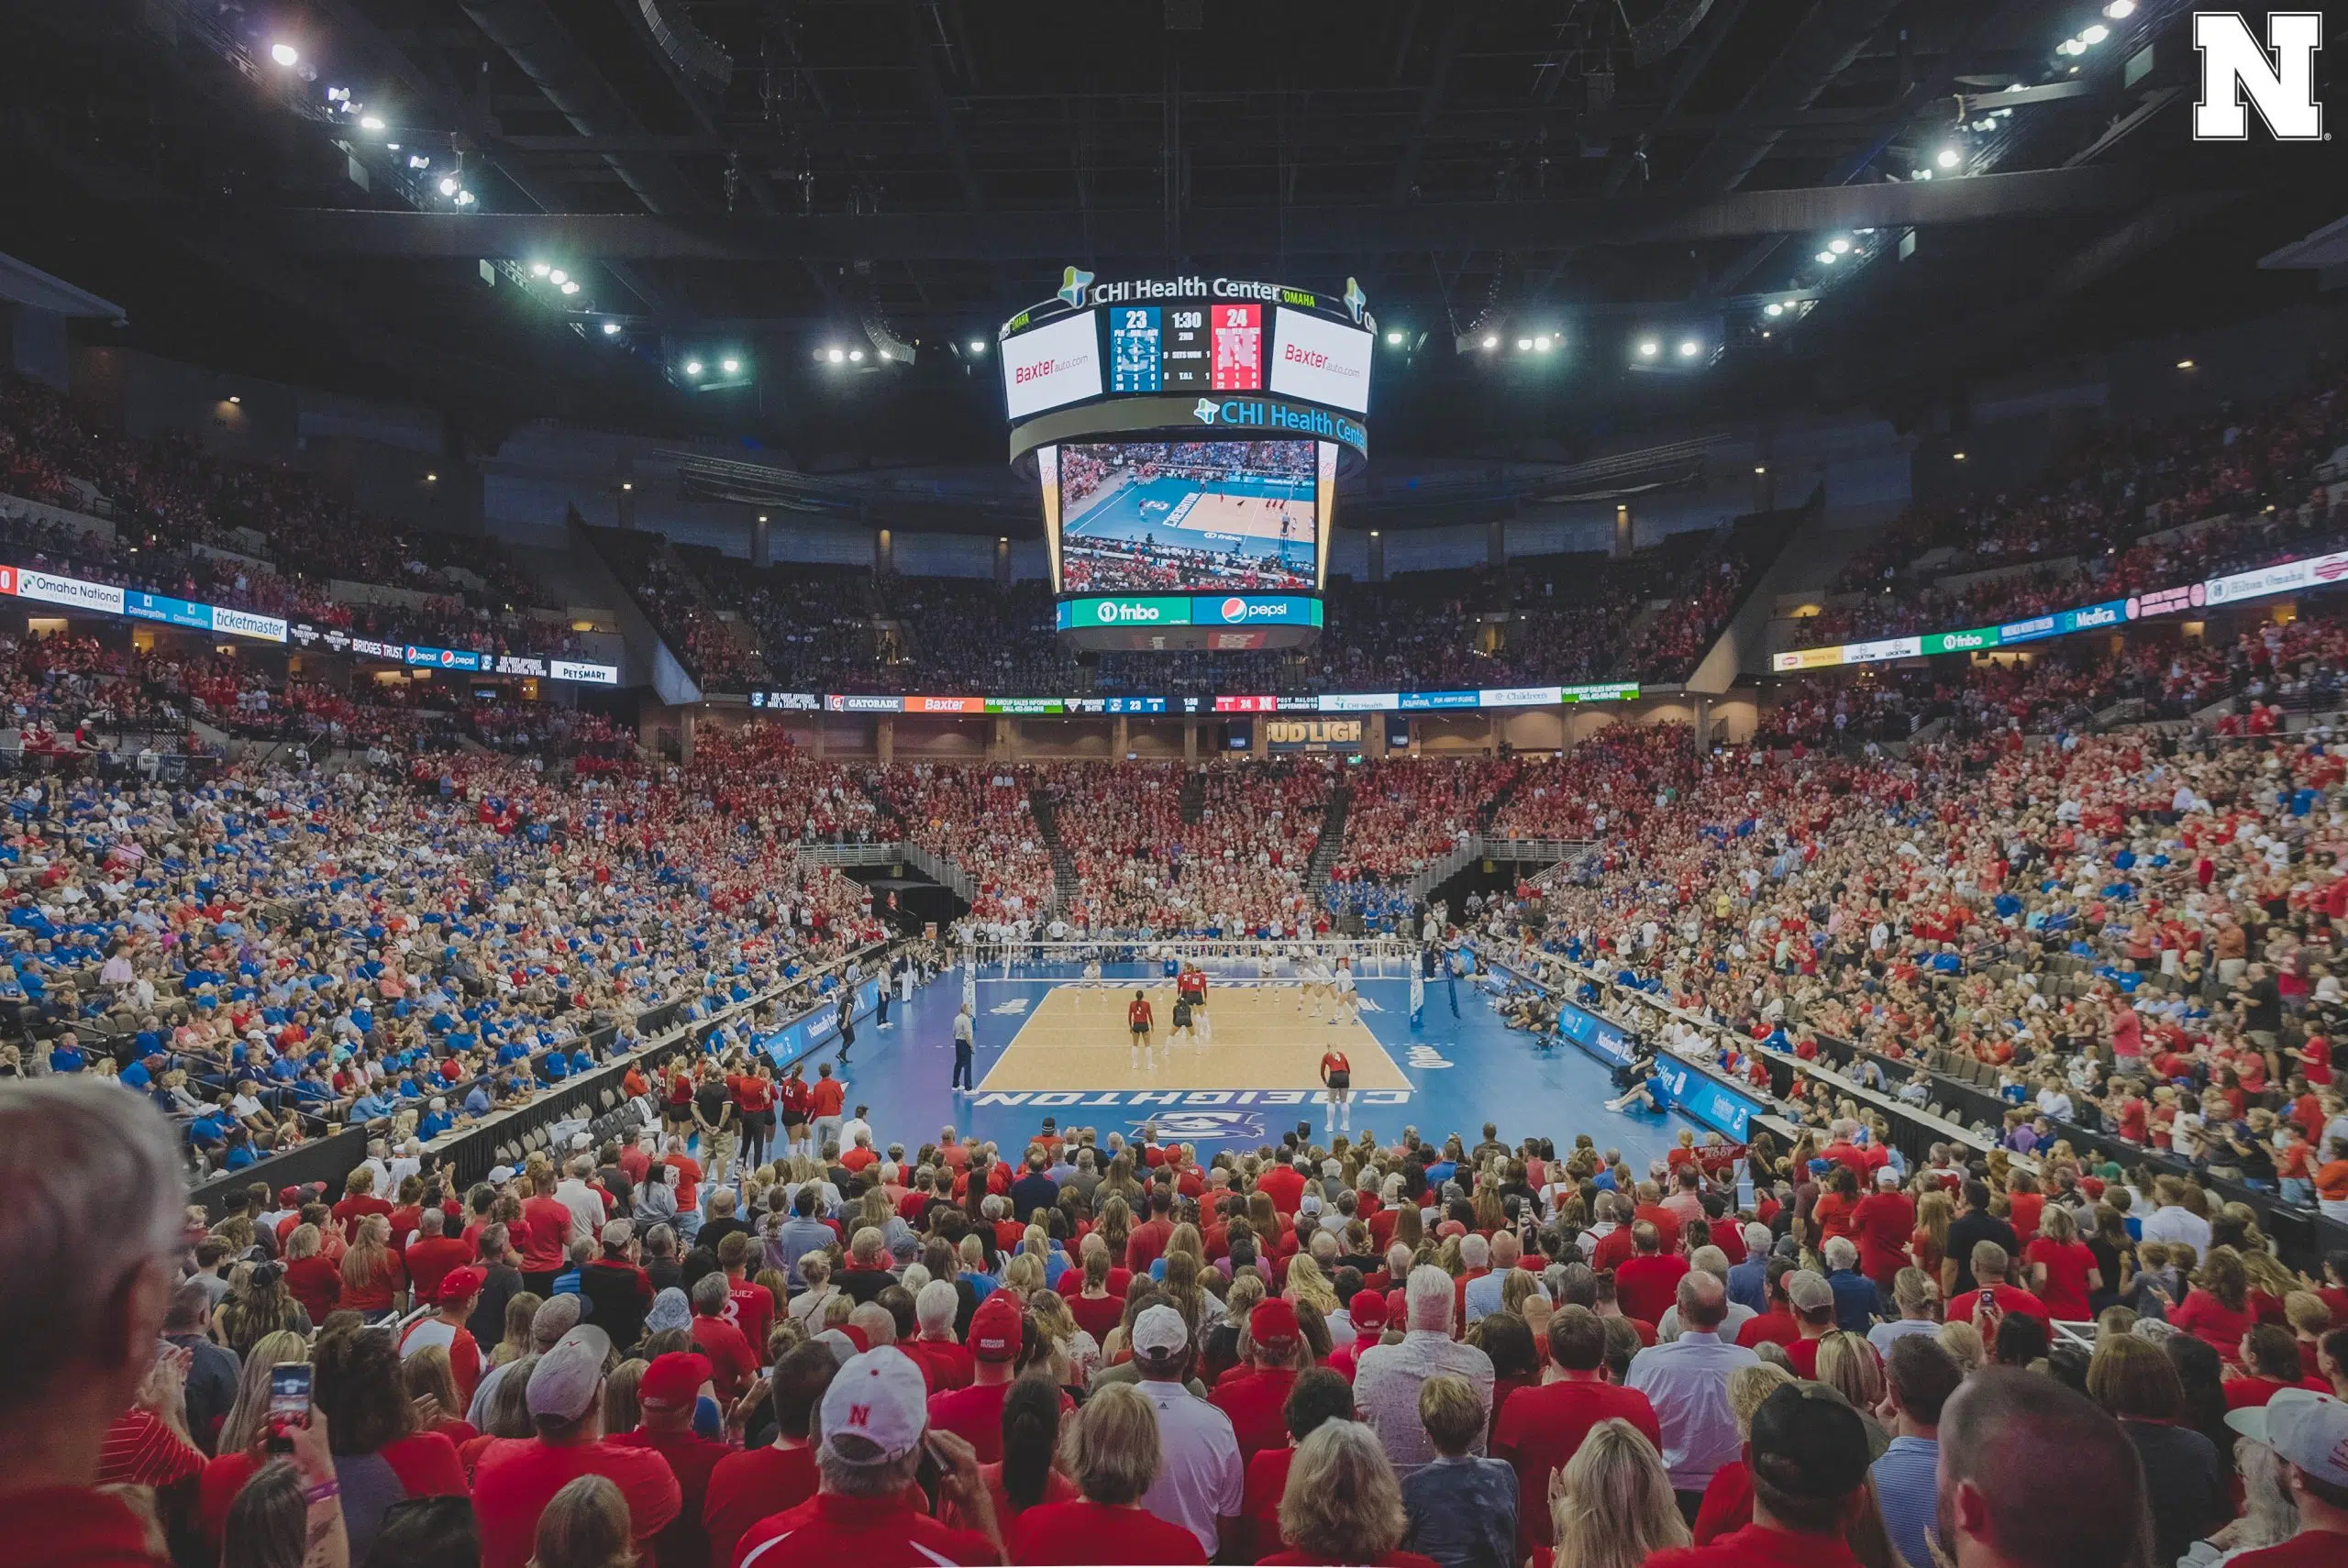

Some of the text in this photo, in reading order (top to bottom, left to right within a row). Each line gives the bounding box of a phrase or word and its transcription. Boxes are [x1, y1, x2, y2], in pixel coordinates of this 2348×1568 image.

[1094, 276, 1280, 304] CHI Health Center
[1284, 290, 1315, 308] OMAHA
[1125, 310, 1147, 329] 23
[1172, 312, 1202, 328] 1:30
[1227, 308, 1248, 327] 24
[1221, 402, 1264, 425] CHI
[1271, 404, 1332, 436] Health
[37, 578, 120, 603] Omaha National
[1120, 602, 1159, 621] fnbo
[1248, 603, 1287, 617] pepsi
[216, 610, 283, 635] ticketmaster
[353, 639, 382, 656] BRIDGES
[1957, 634, 1982, 647] fnbo
[417, 653, 437, 661] pepsi
[456, 657, 475, 666] pepsi
[848, 699, 899, 709] GATORADE
[925, 699, 965, 712] Baxter
[1130, 701, 1141, 710] 23
[1241, 699, 1251, 709] 24
[785, 1085, 793, 1098] 13
[847, 1405, 870, 1426] N
